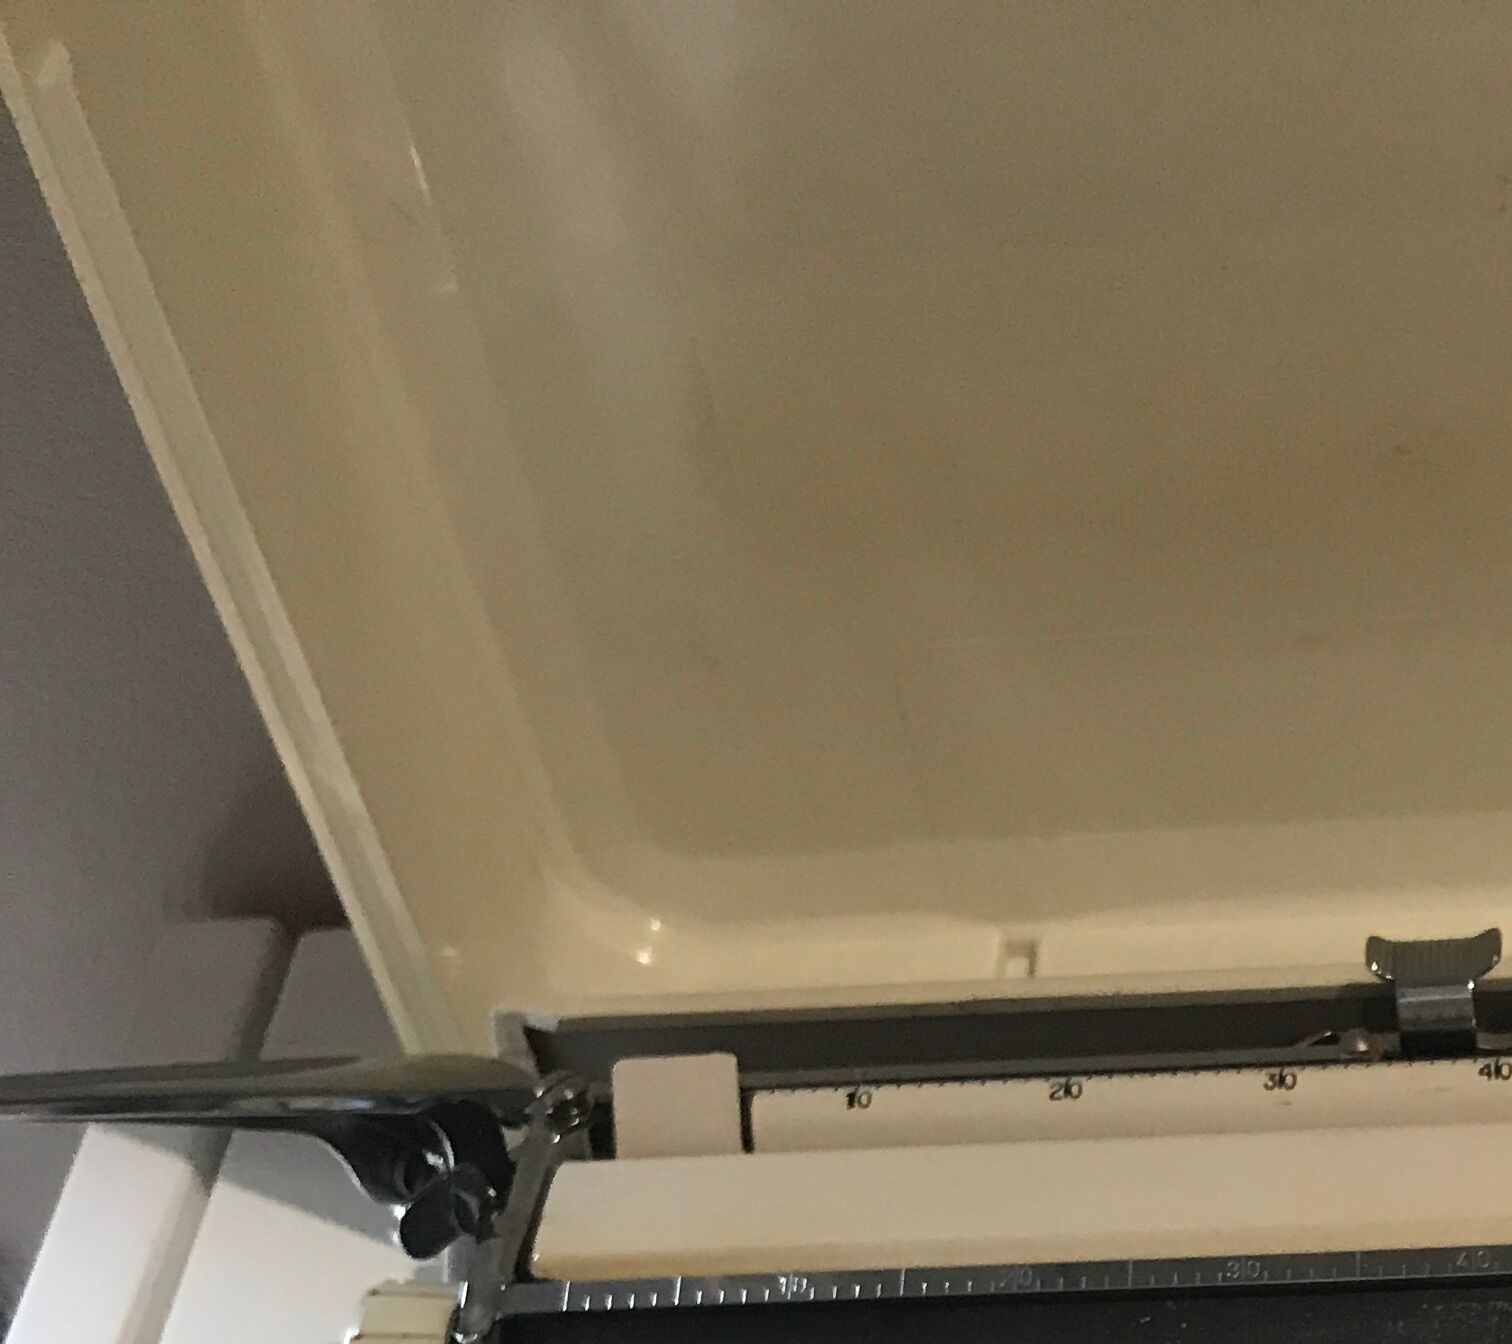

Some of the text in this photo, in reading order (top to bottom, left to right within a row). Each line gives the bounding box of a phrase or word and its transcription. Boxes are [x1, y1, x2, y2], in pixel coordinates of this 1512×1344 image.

[846, 1090, 872, 1110] 10
[1049, 1079, 1083, 1101] 20
[1263, 1071, 1298, 1091] 30
[1478, 1062, 1512, 1081] 40
